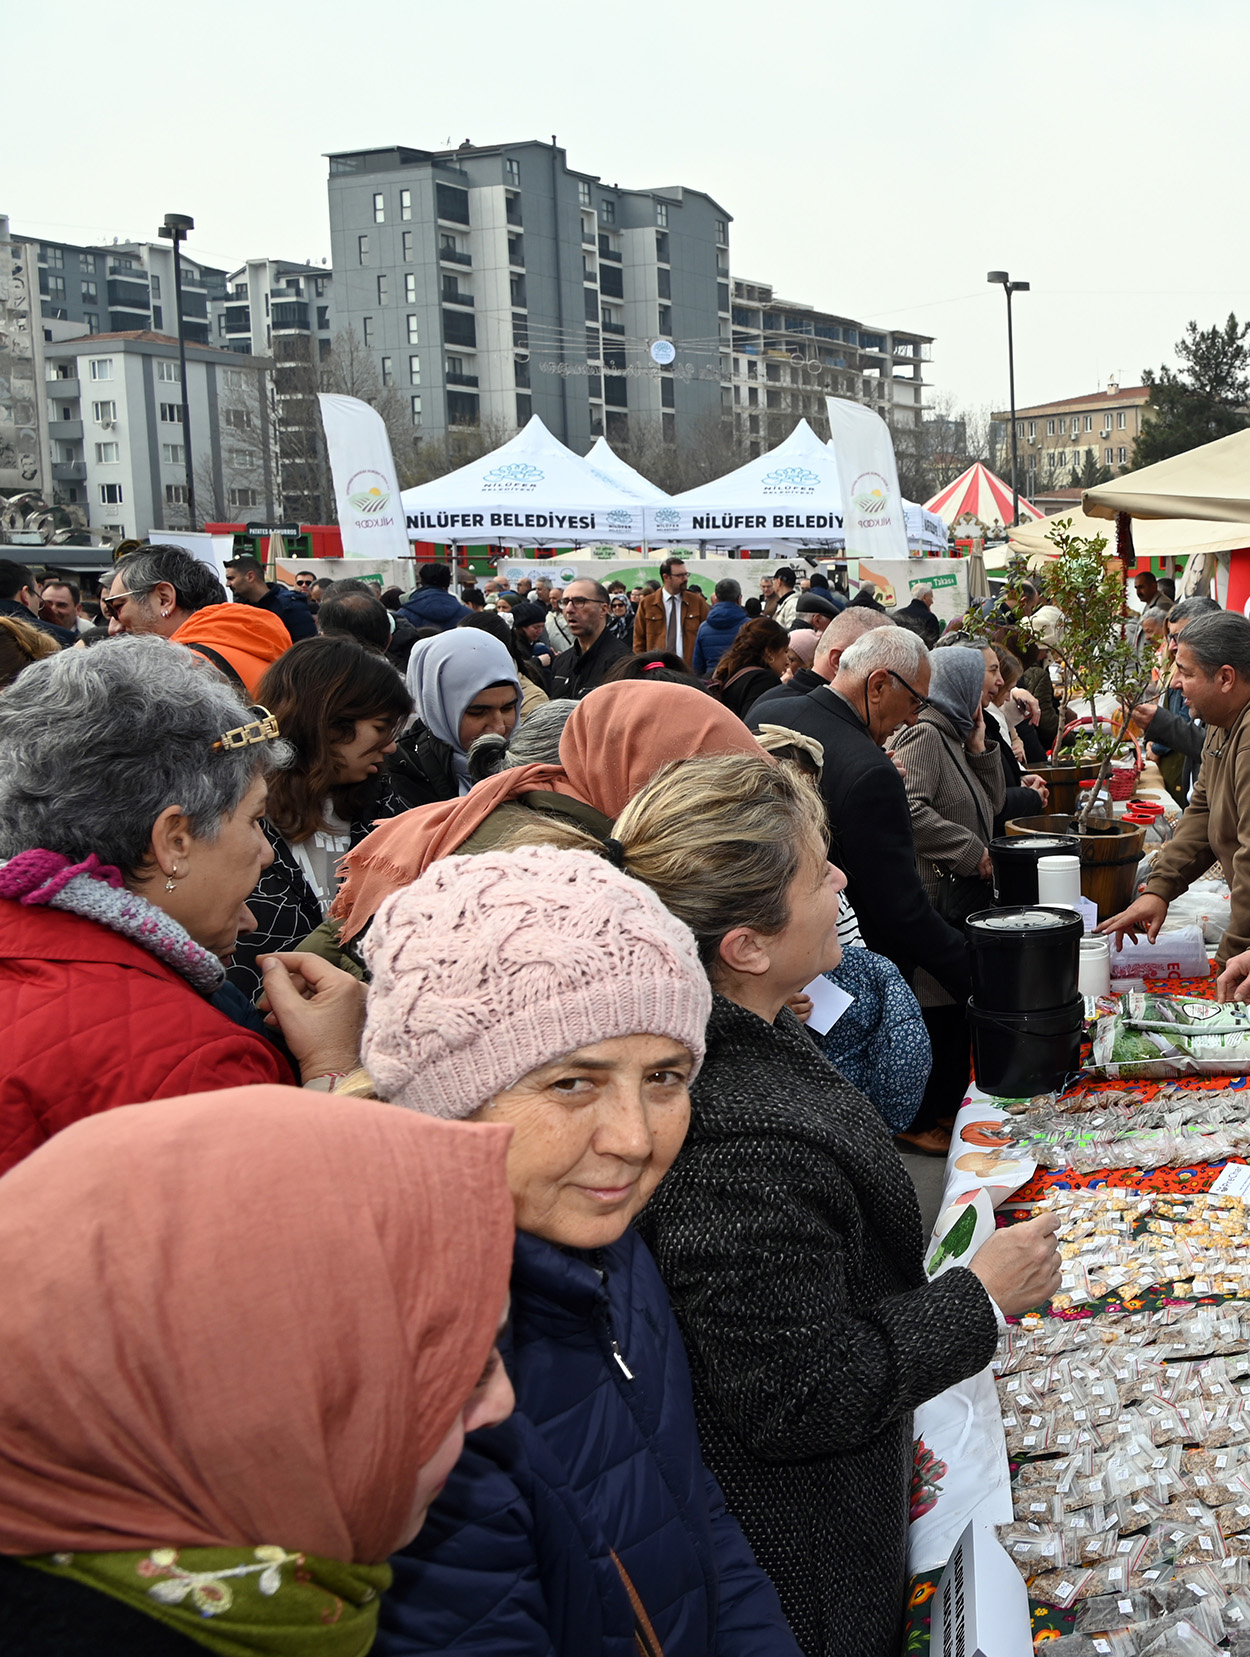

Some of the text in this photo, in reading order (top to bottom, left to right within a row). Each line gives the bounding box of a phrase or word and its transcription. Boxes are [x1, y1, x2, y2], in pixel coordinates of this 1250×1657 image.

[407, 511, 596, 530] NİLÜFER BELEDİYESİ
[692, 511, 767, 530] NİLÜFER
